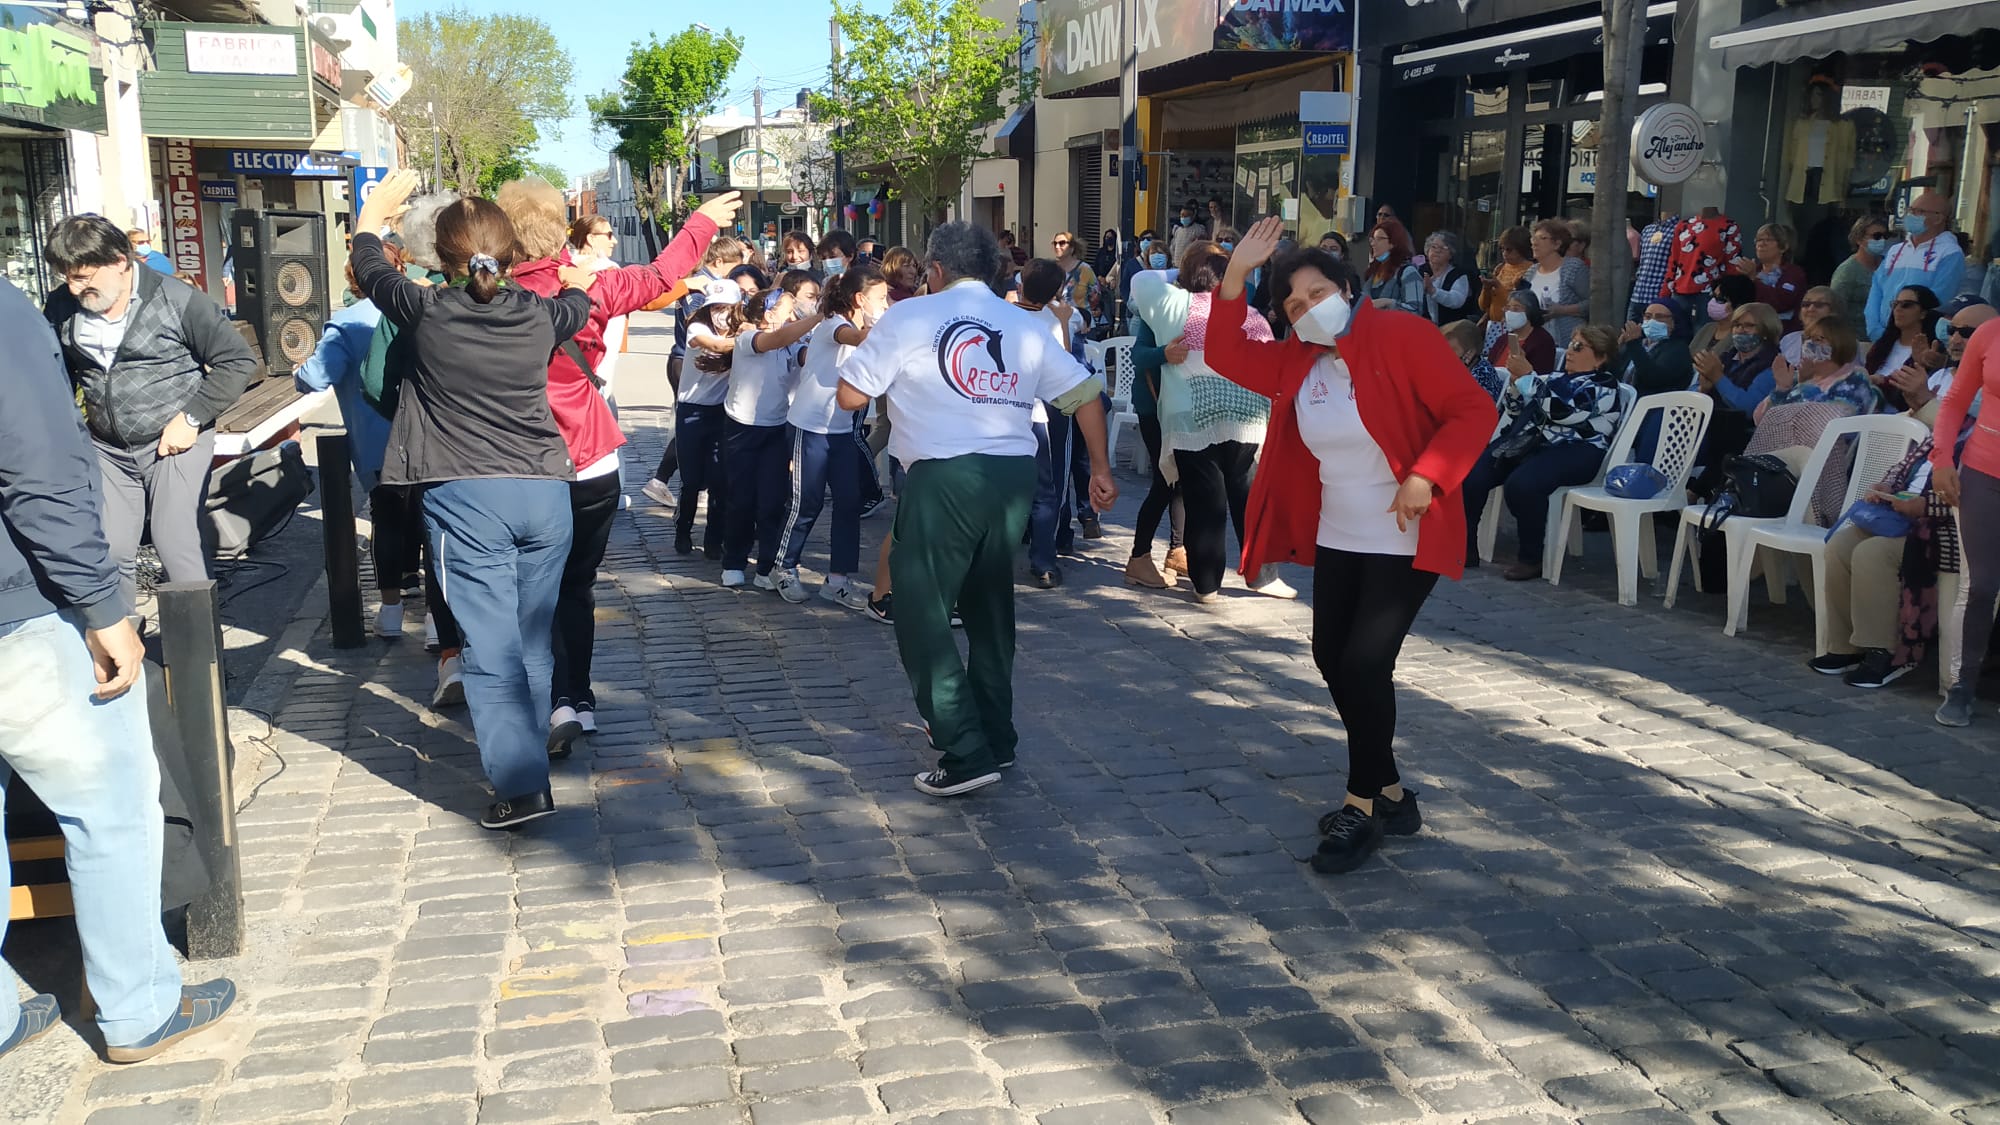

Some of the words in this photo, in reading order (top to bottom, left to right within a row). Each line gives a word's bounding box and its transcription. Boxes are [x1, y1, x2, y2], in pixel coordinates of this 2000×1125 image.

[1306, 131, 1345, 145] CREDITEL
[1644, 134, 1705, 160] Alejandro
[202, 185, 235, 196] CREDITEL
[932, 325, 946, 353] CENTRO
